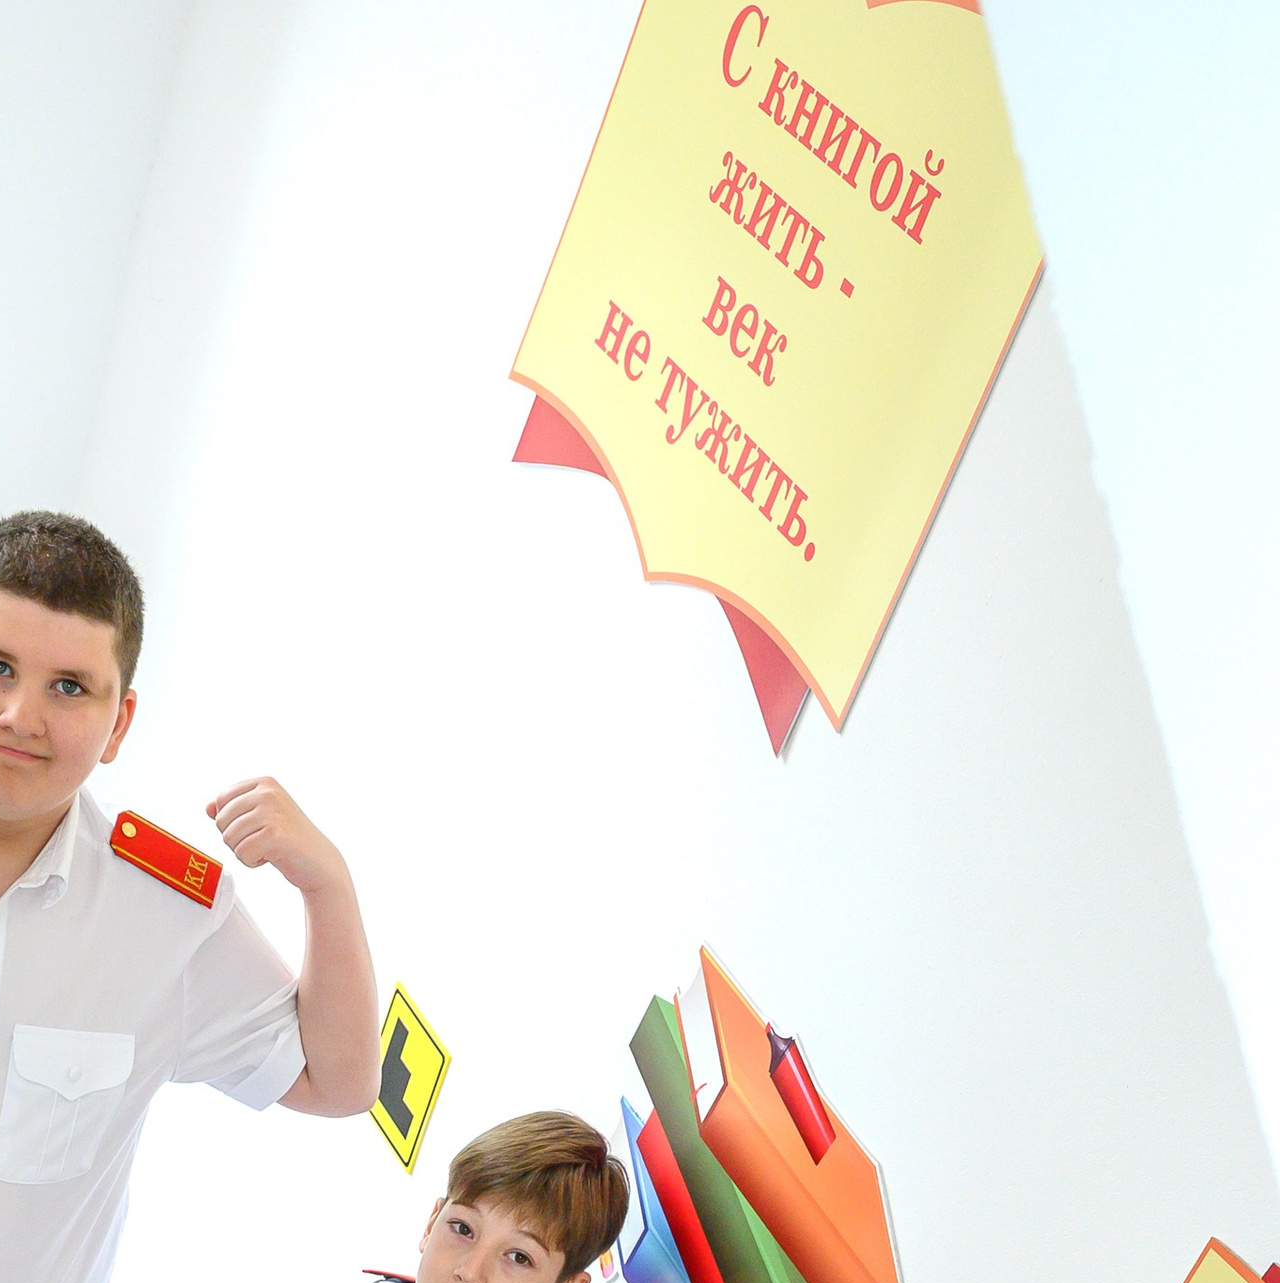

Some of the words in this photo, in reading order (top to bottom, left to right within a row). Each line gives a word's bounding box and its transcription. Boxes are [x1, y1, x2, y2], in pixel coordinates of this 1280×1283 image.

[722, 4, 770, 88] С
[757, 57, 945, 245] книгой
[708, 150, 827, 290] жить
[701, 275, 789, 388] век
[593, 299, 652, 382] не
[654, 356, 817, 563] тужить.
[184, 854, 208, 890] КК
